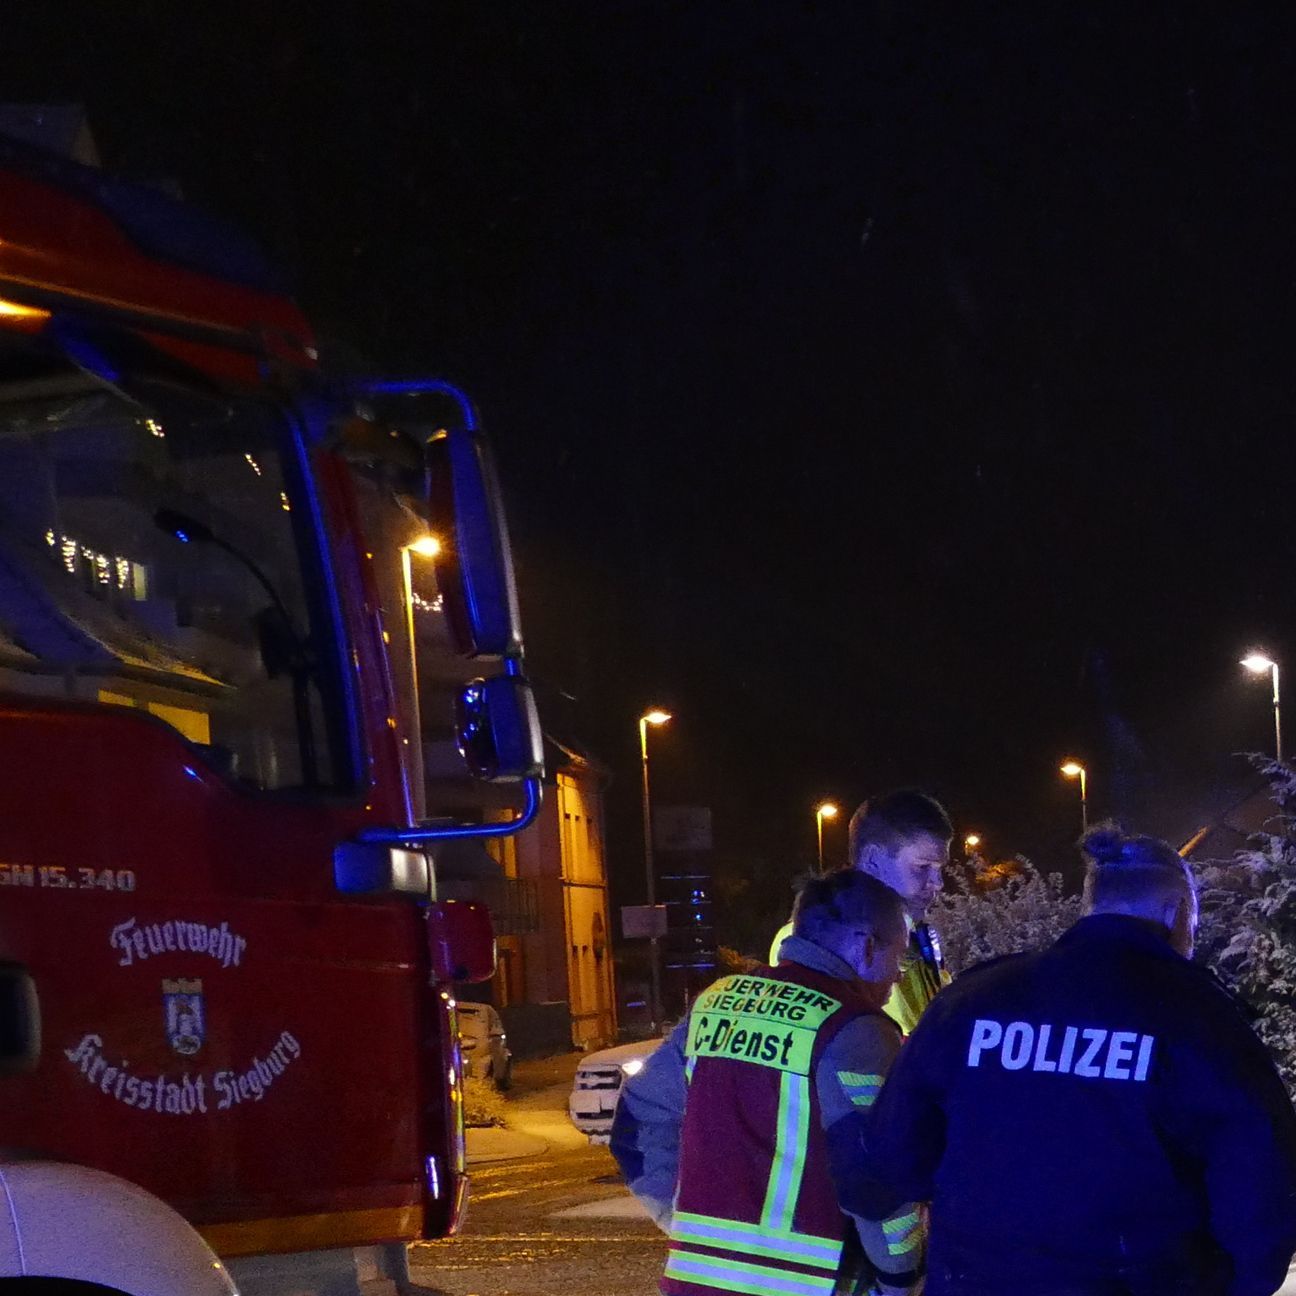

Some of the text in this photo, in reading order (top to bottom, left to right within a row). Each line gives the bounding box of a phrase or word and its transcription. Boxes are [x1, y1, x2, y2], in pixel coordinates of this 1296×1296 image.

[38, 866, 136, 891] 15.340
[110, 916, 247, 968] Feuerwehr
[703, 994, 807, 1021] SIEGBURG
[708, 977, 834, 1012] UERWEHR
[694, 1016, 794, 1066] C-Dienst
[968, 1019, 1154, 1081] POLIZEI
[64, 1030, 301, 1114] Kreisstadt Siegburg
